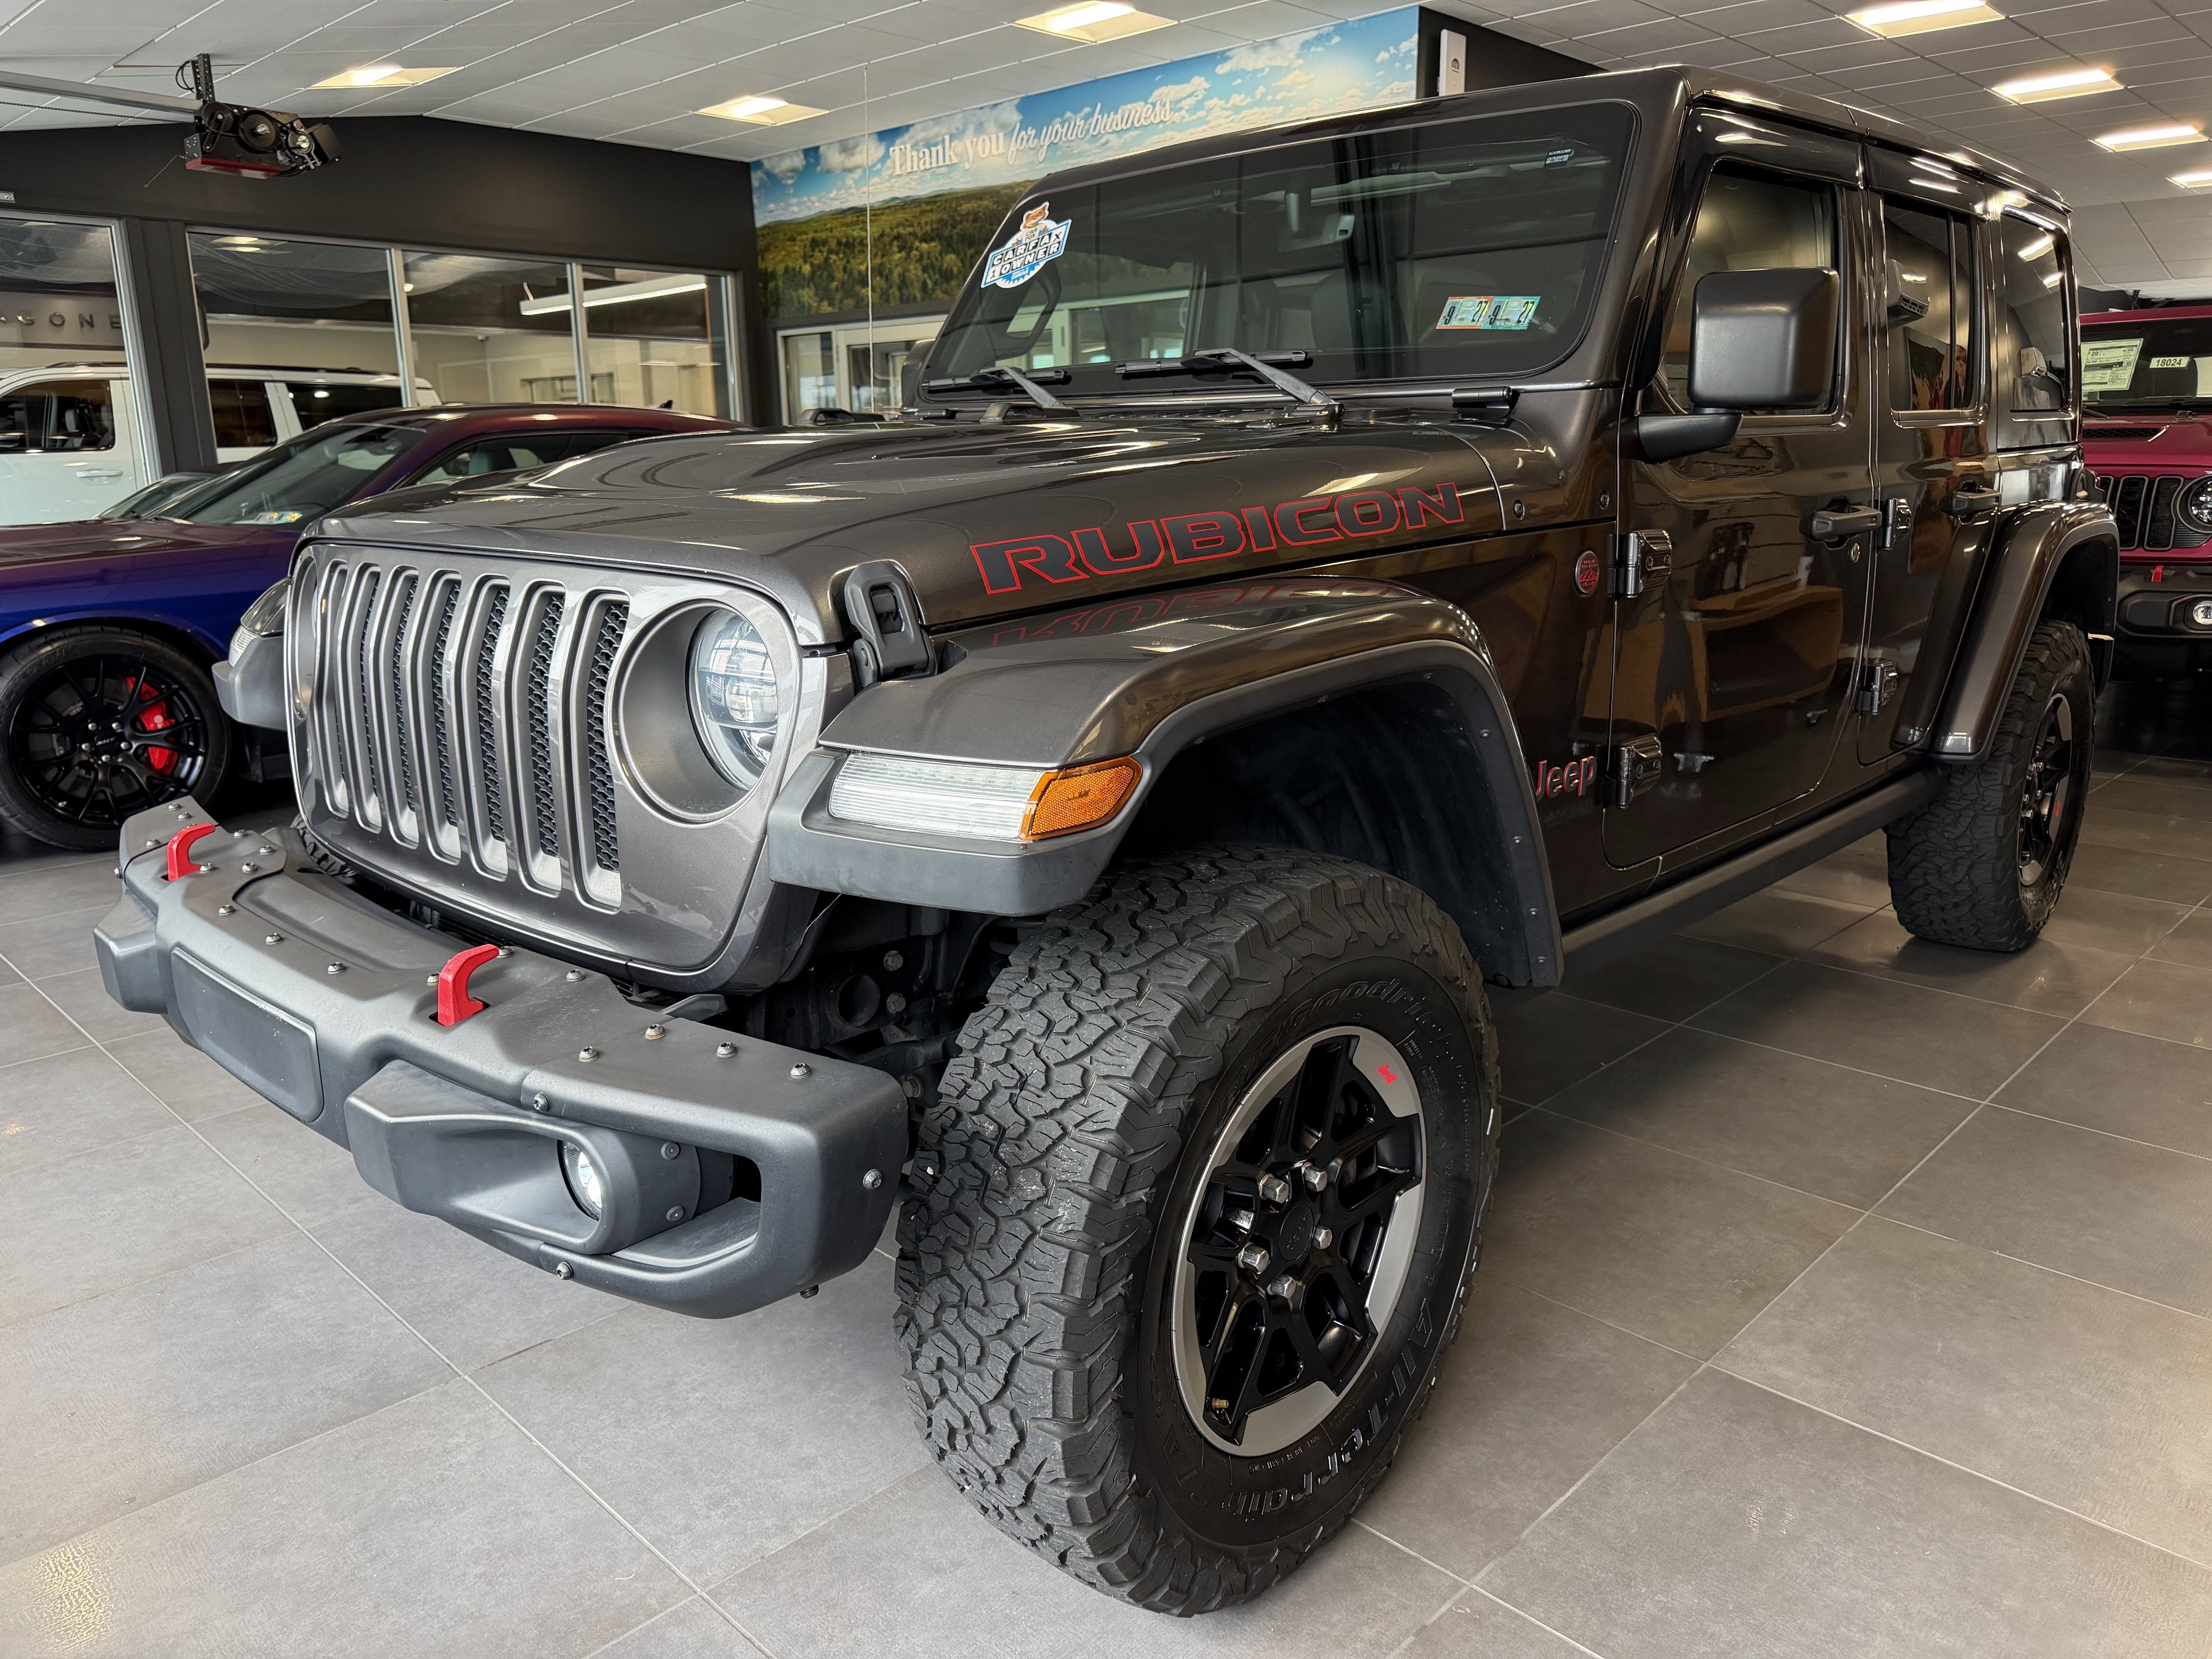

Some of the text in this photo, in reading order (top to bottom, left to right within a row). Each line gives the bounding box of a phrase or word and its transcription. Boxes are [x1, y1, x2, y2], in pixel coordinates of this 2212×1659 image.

[889, 98, 1174, 175] Thank you for your business
[990, 243, 1059, 279] 1 OWNER
[993, 231, 1063, 265] CARFAX
[0, 310, 121, 329] GONE
[1471, 300, 1489, 324] 27
[1517, 301, 1535, 324] 27
[2156, 359, 2182, 367] 18024
[970, 482, 1464, 594] RUBICON
[1535, 756, 1597, 802] Jeep
